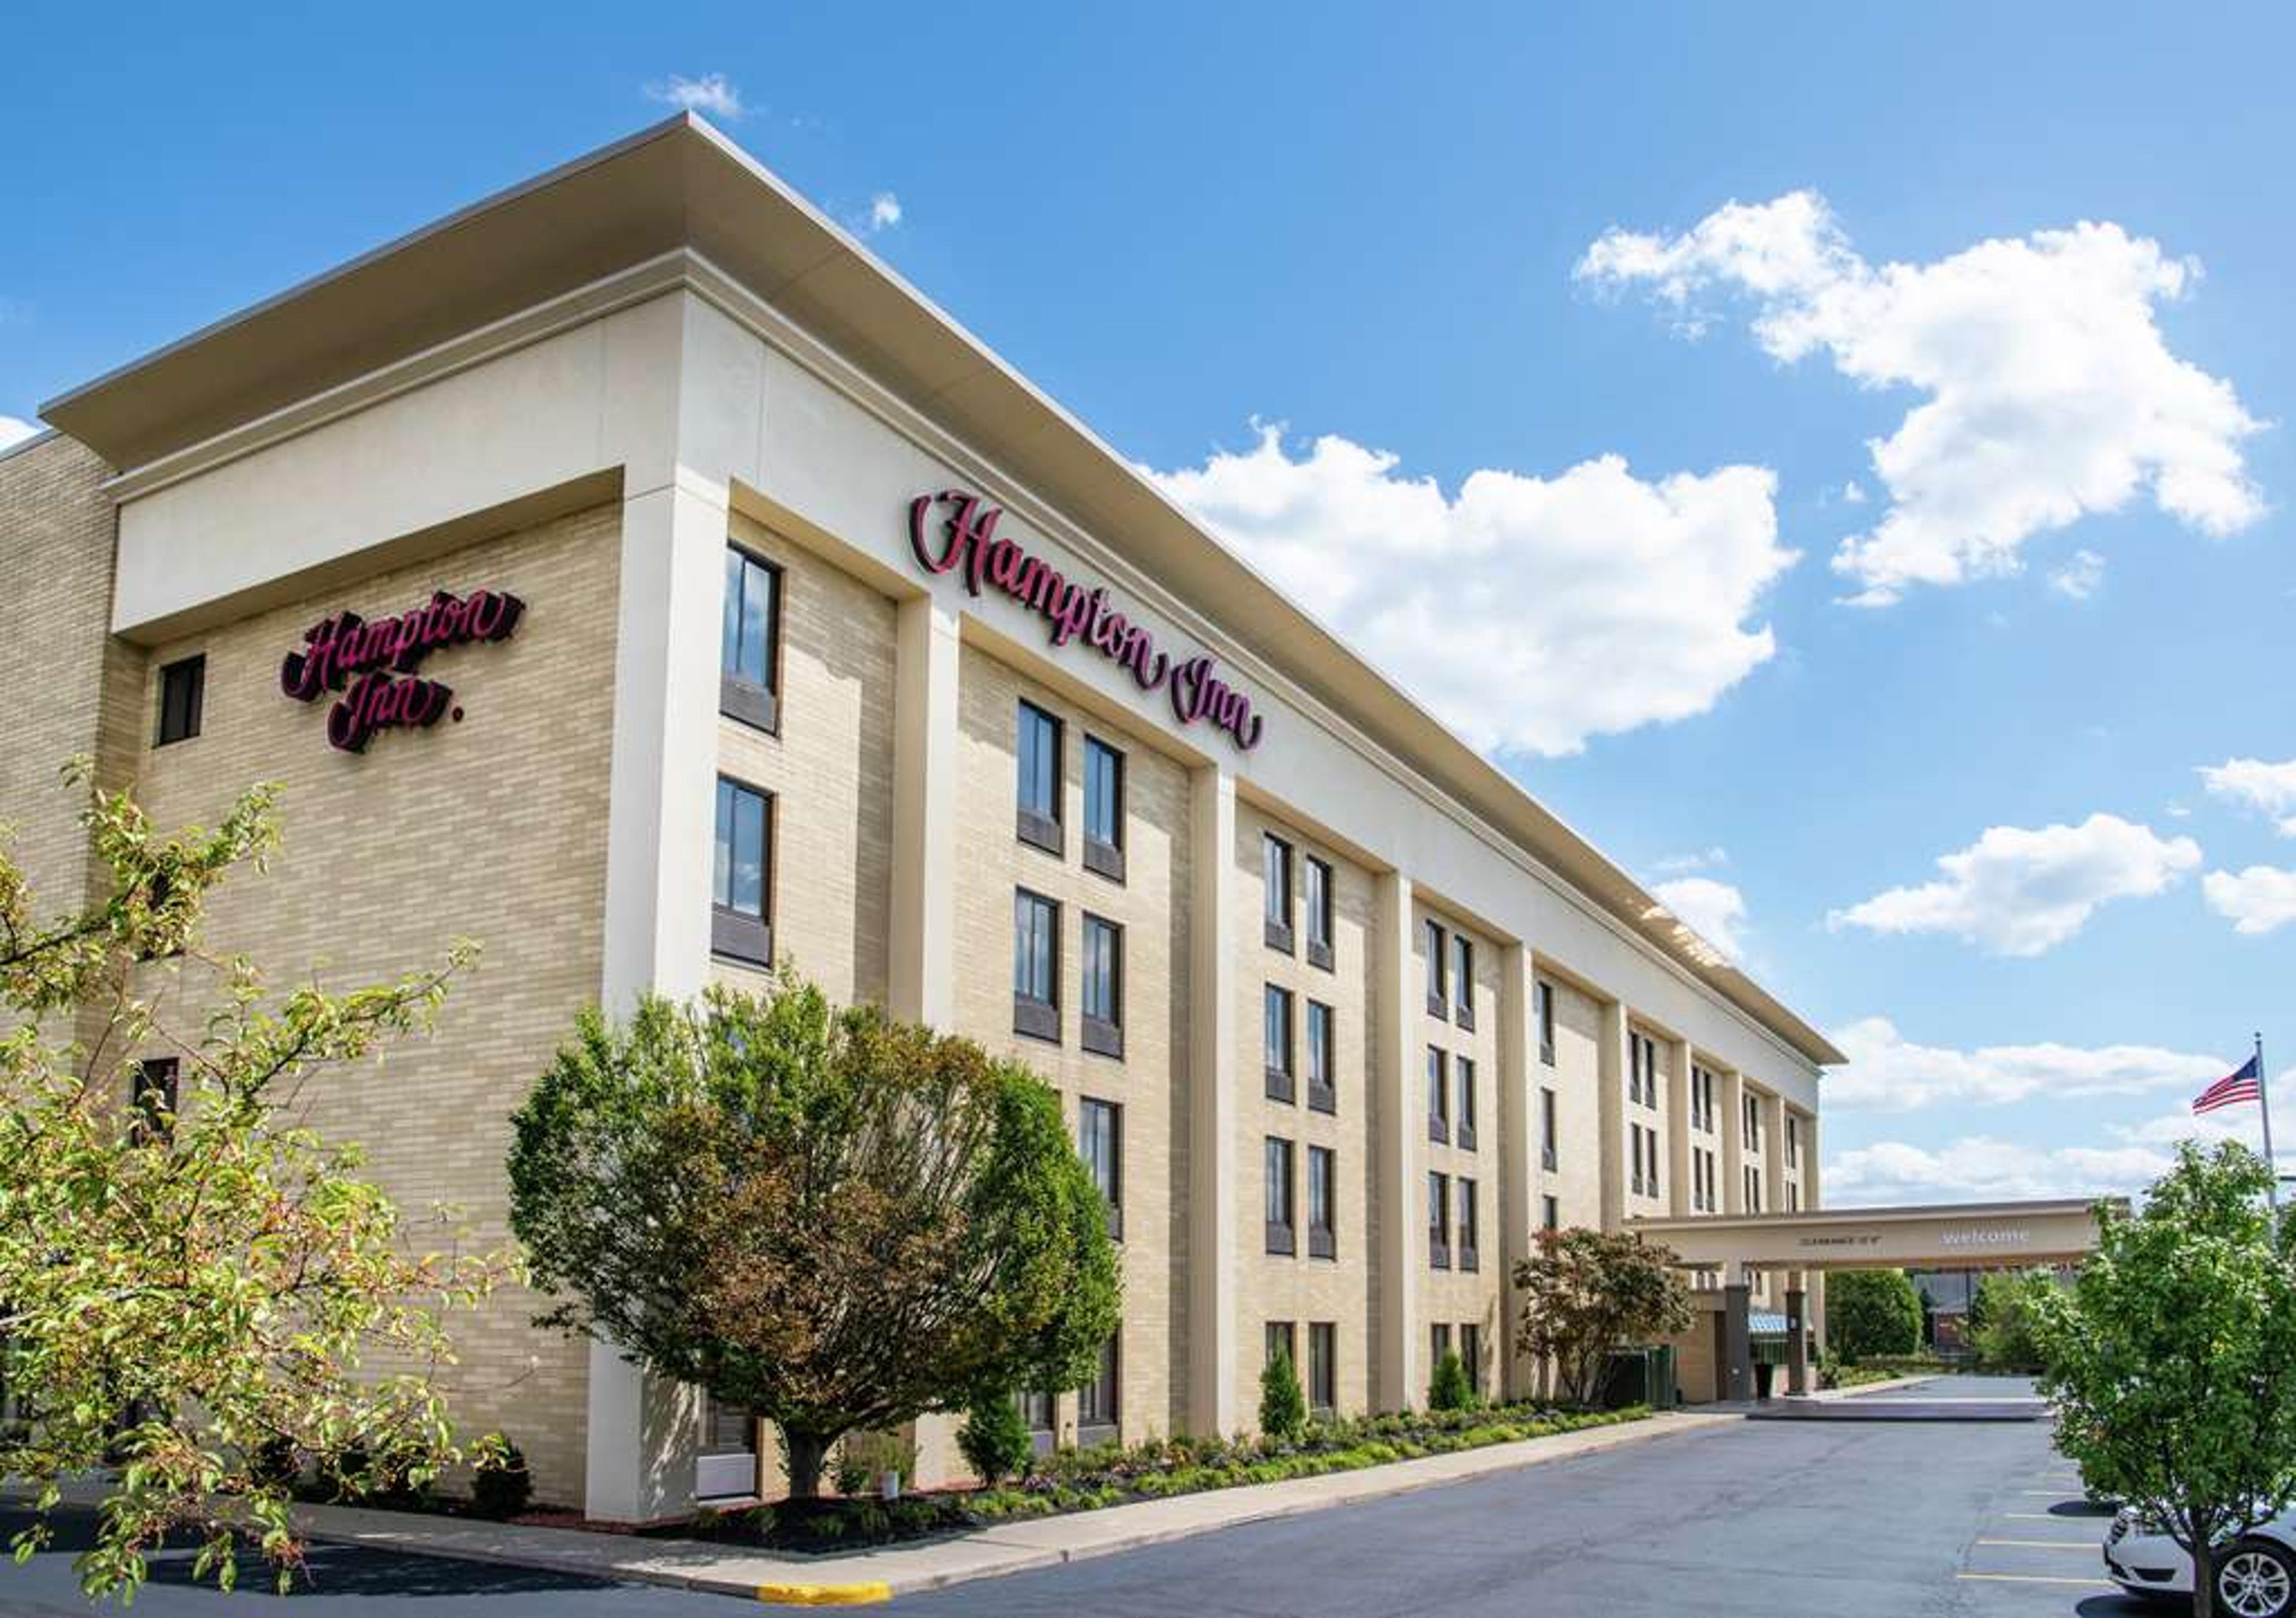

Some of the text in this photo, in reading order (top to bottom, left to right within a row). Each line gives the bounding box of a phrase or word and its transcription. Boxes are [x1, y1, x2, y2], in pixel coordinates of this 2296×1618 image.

[282, 590, 526, 703] Hampton
[909, 489, 1262, 750] Hampton Inn
[327, 671, 453, 753] Inn
[1940, 1229, 2030, 1244] welcome
